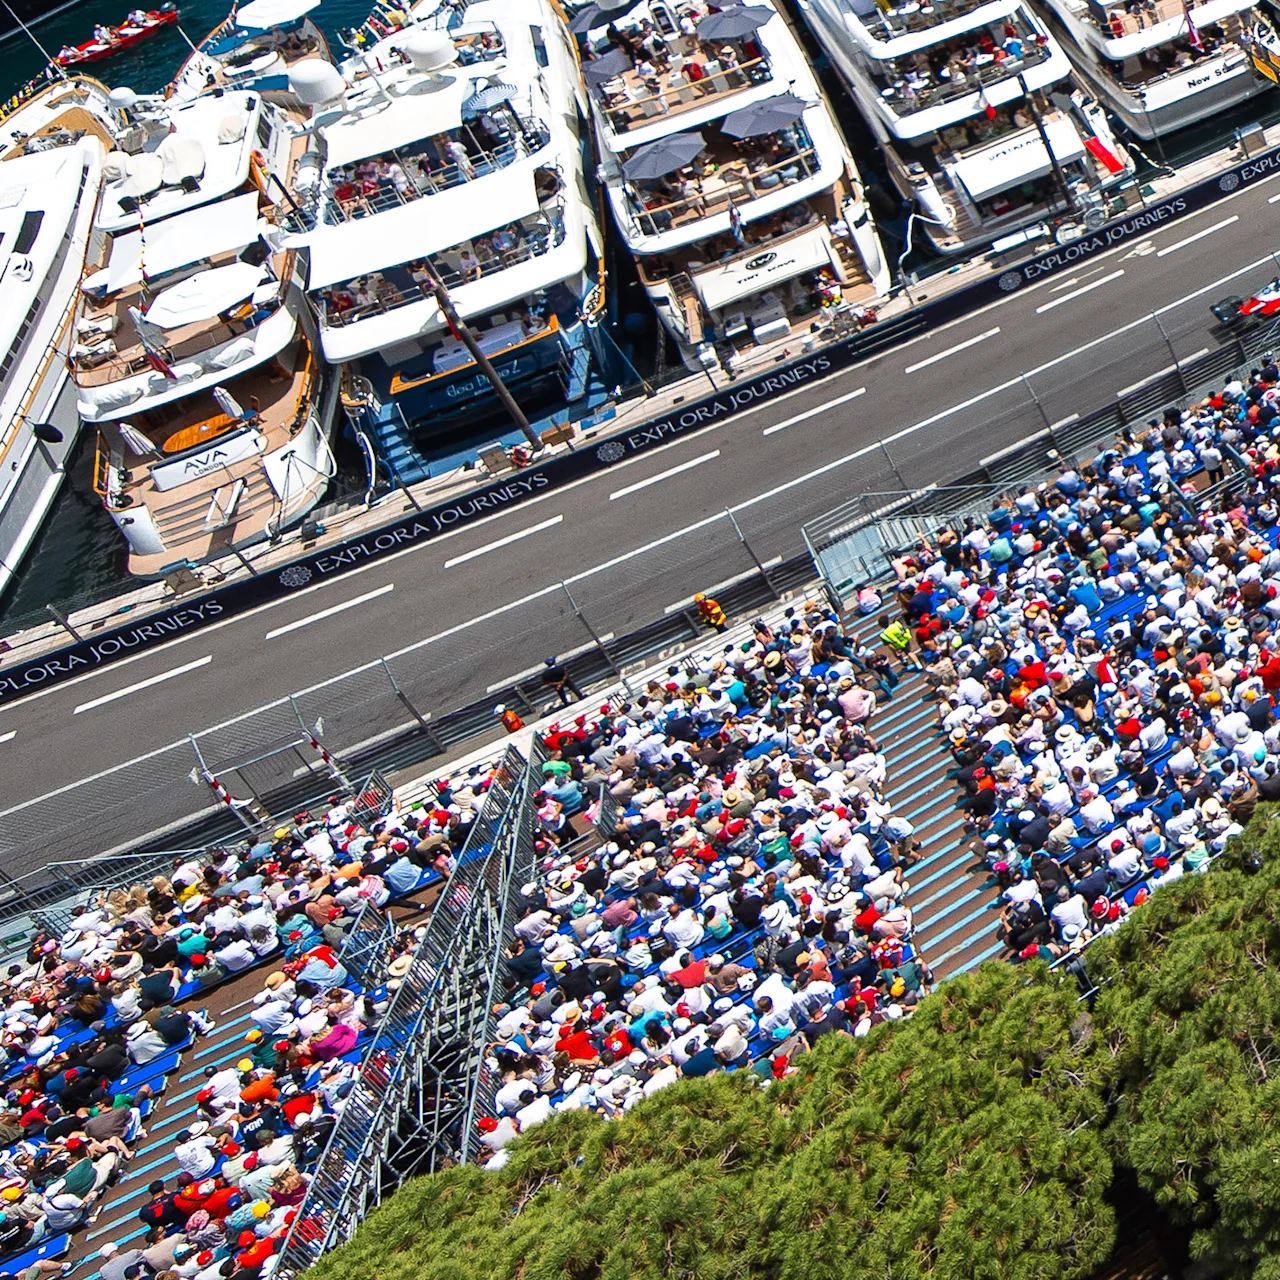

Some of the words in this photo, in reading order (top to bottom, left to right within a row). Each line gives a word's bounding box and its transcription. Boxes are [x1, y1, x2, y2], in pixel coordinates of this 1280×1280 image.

[1187, 74, 1210, 88] New
[1024, 241, 1104, 280] EXPLORA
[1105, 198, 1187, 249] JOURNEYS
[628, 402, 727, 450] EXPLORA
[731, 356, 831, 411] JOURNEYS
[184, 450, 228, 474] AVA
[193, 461, 224, 477] LONDON
[315, 524, 431, 572] EXPLORA
[433, 472, 549, 538] JOURNEYS
[88, 599, 224, 663] JOURNEYS
